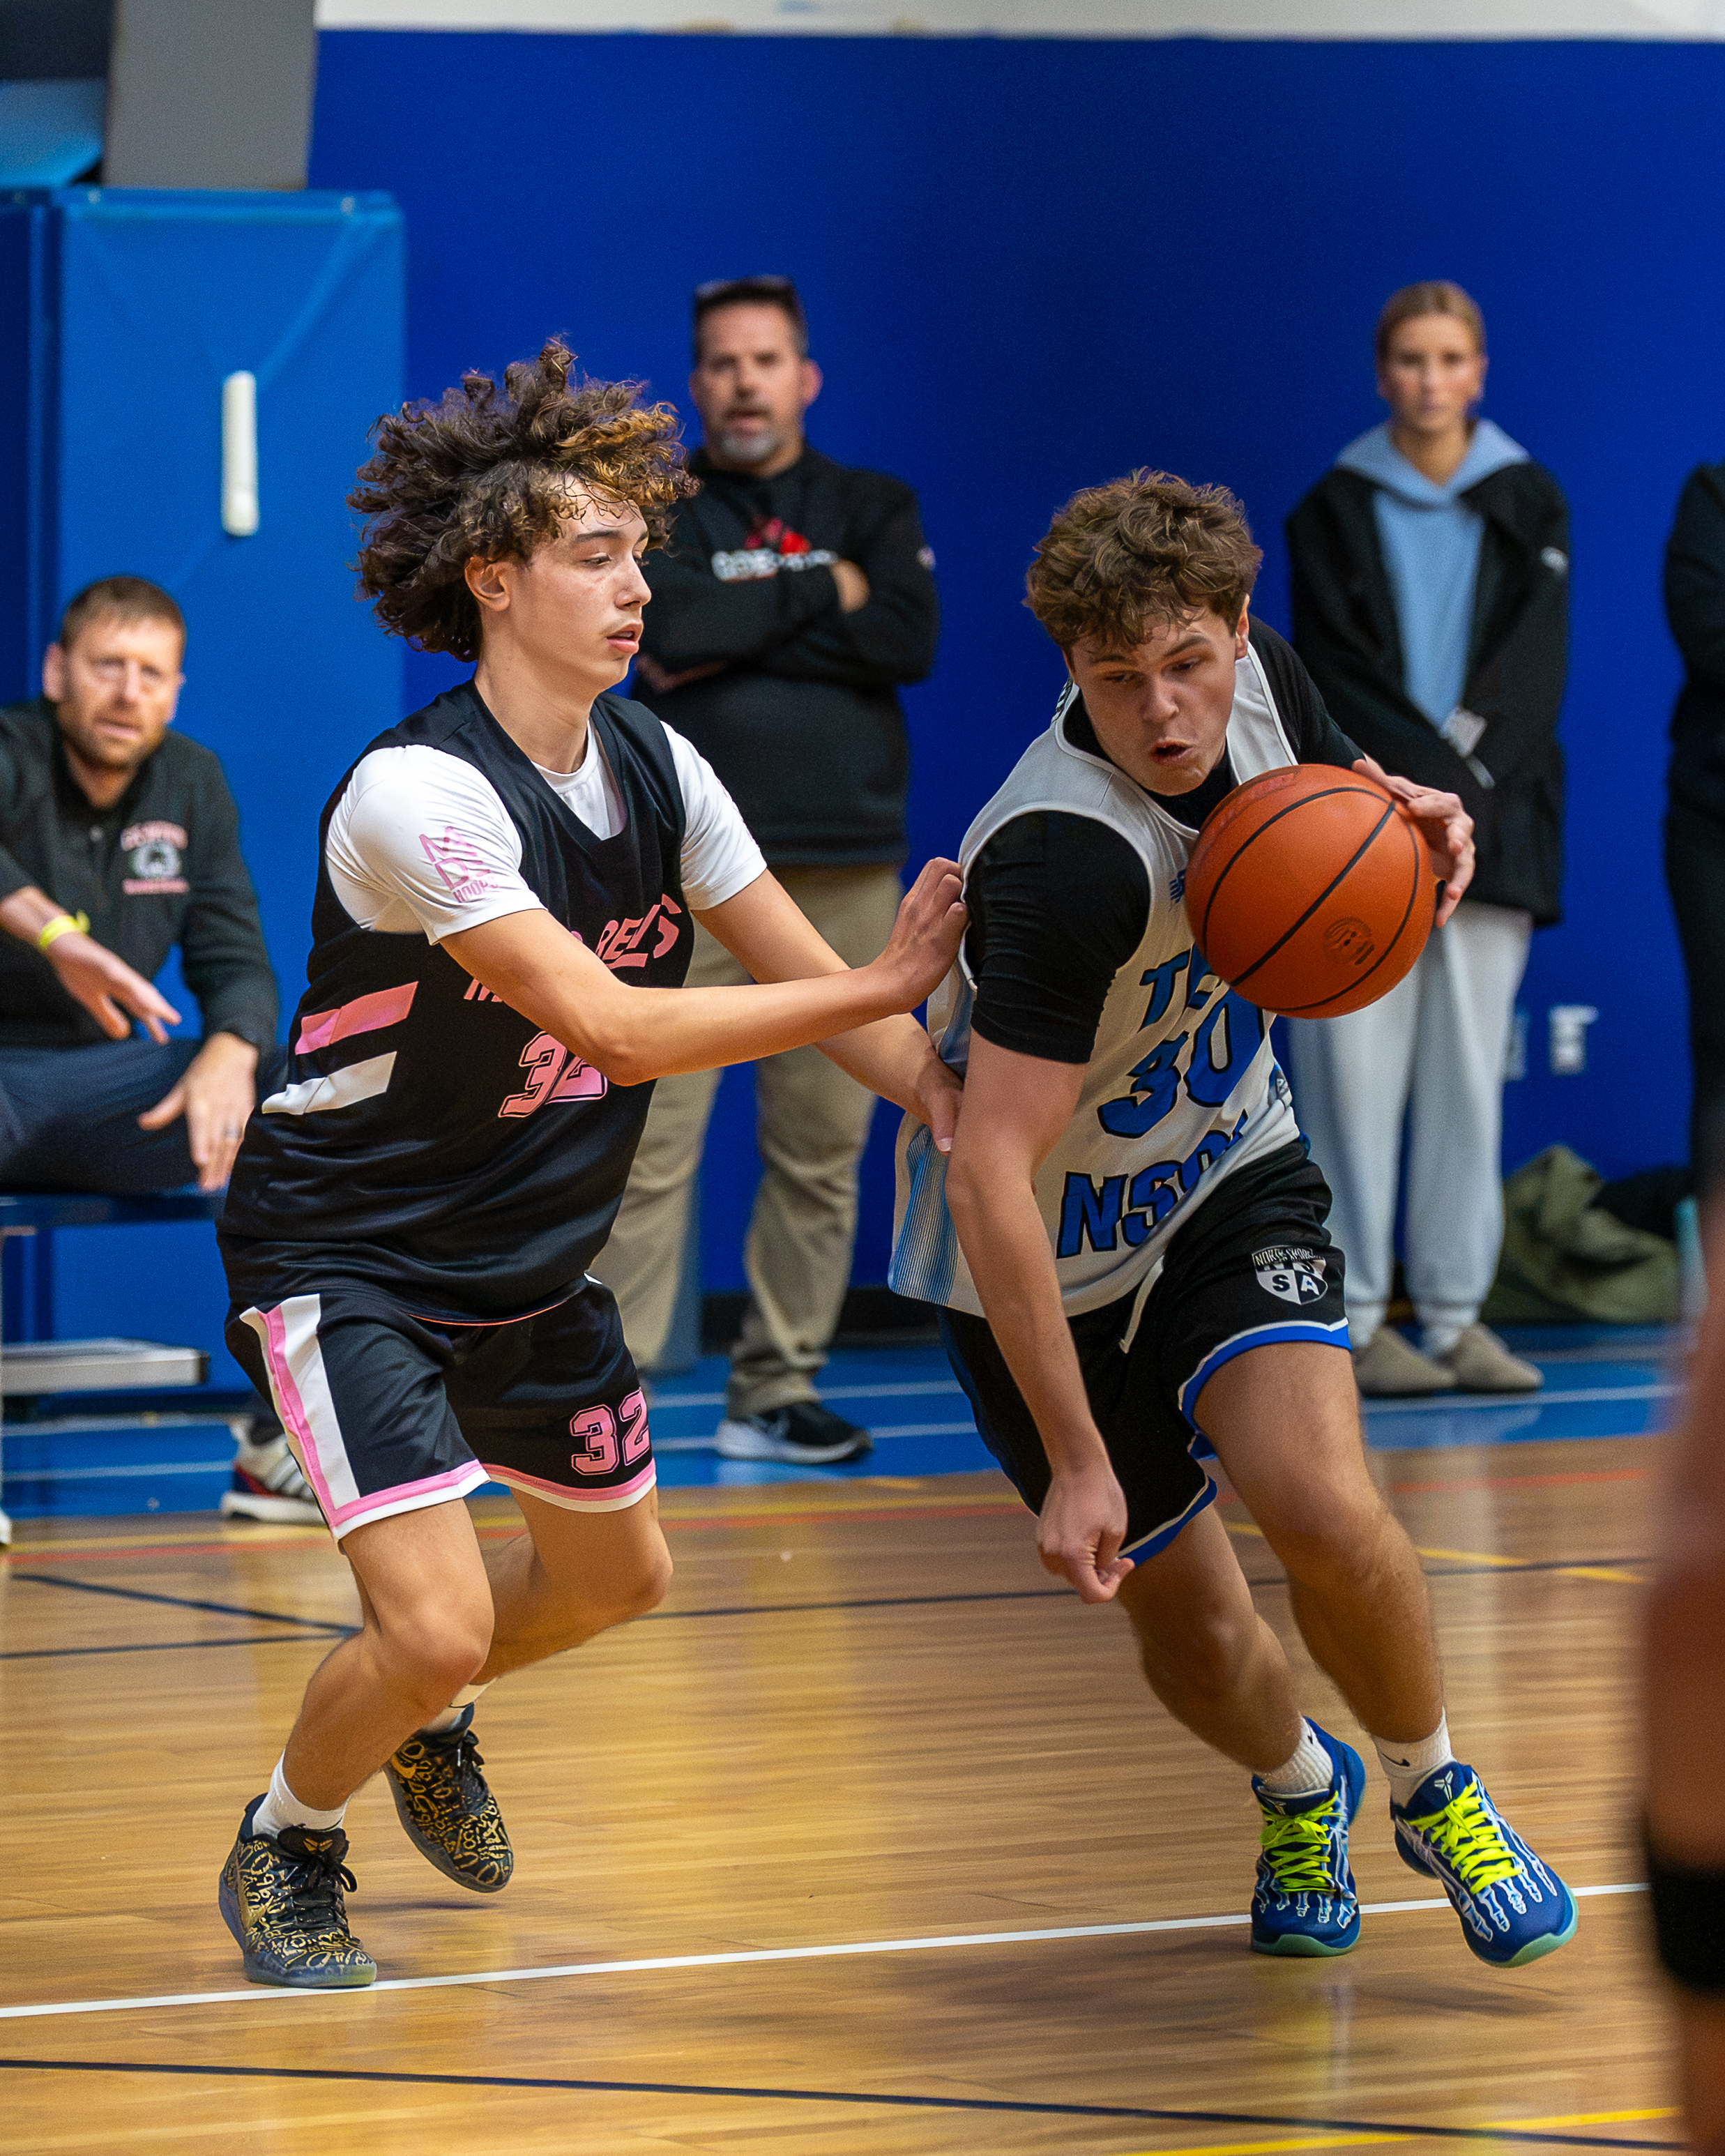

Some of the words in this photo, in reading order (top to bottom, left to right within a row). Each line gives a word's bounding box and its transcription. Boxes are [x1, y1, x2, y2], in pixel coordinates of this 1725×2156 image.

[453, 876, 499, 903] HOOPS
[497, 1030, 608, 1118] 32
[1096, 988, 1264, 1139] 30
[570, 1386, 650, 1476] 32
